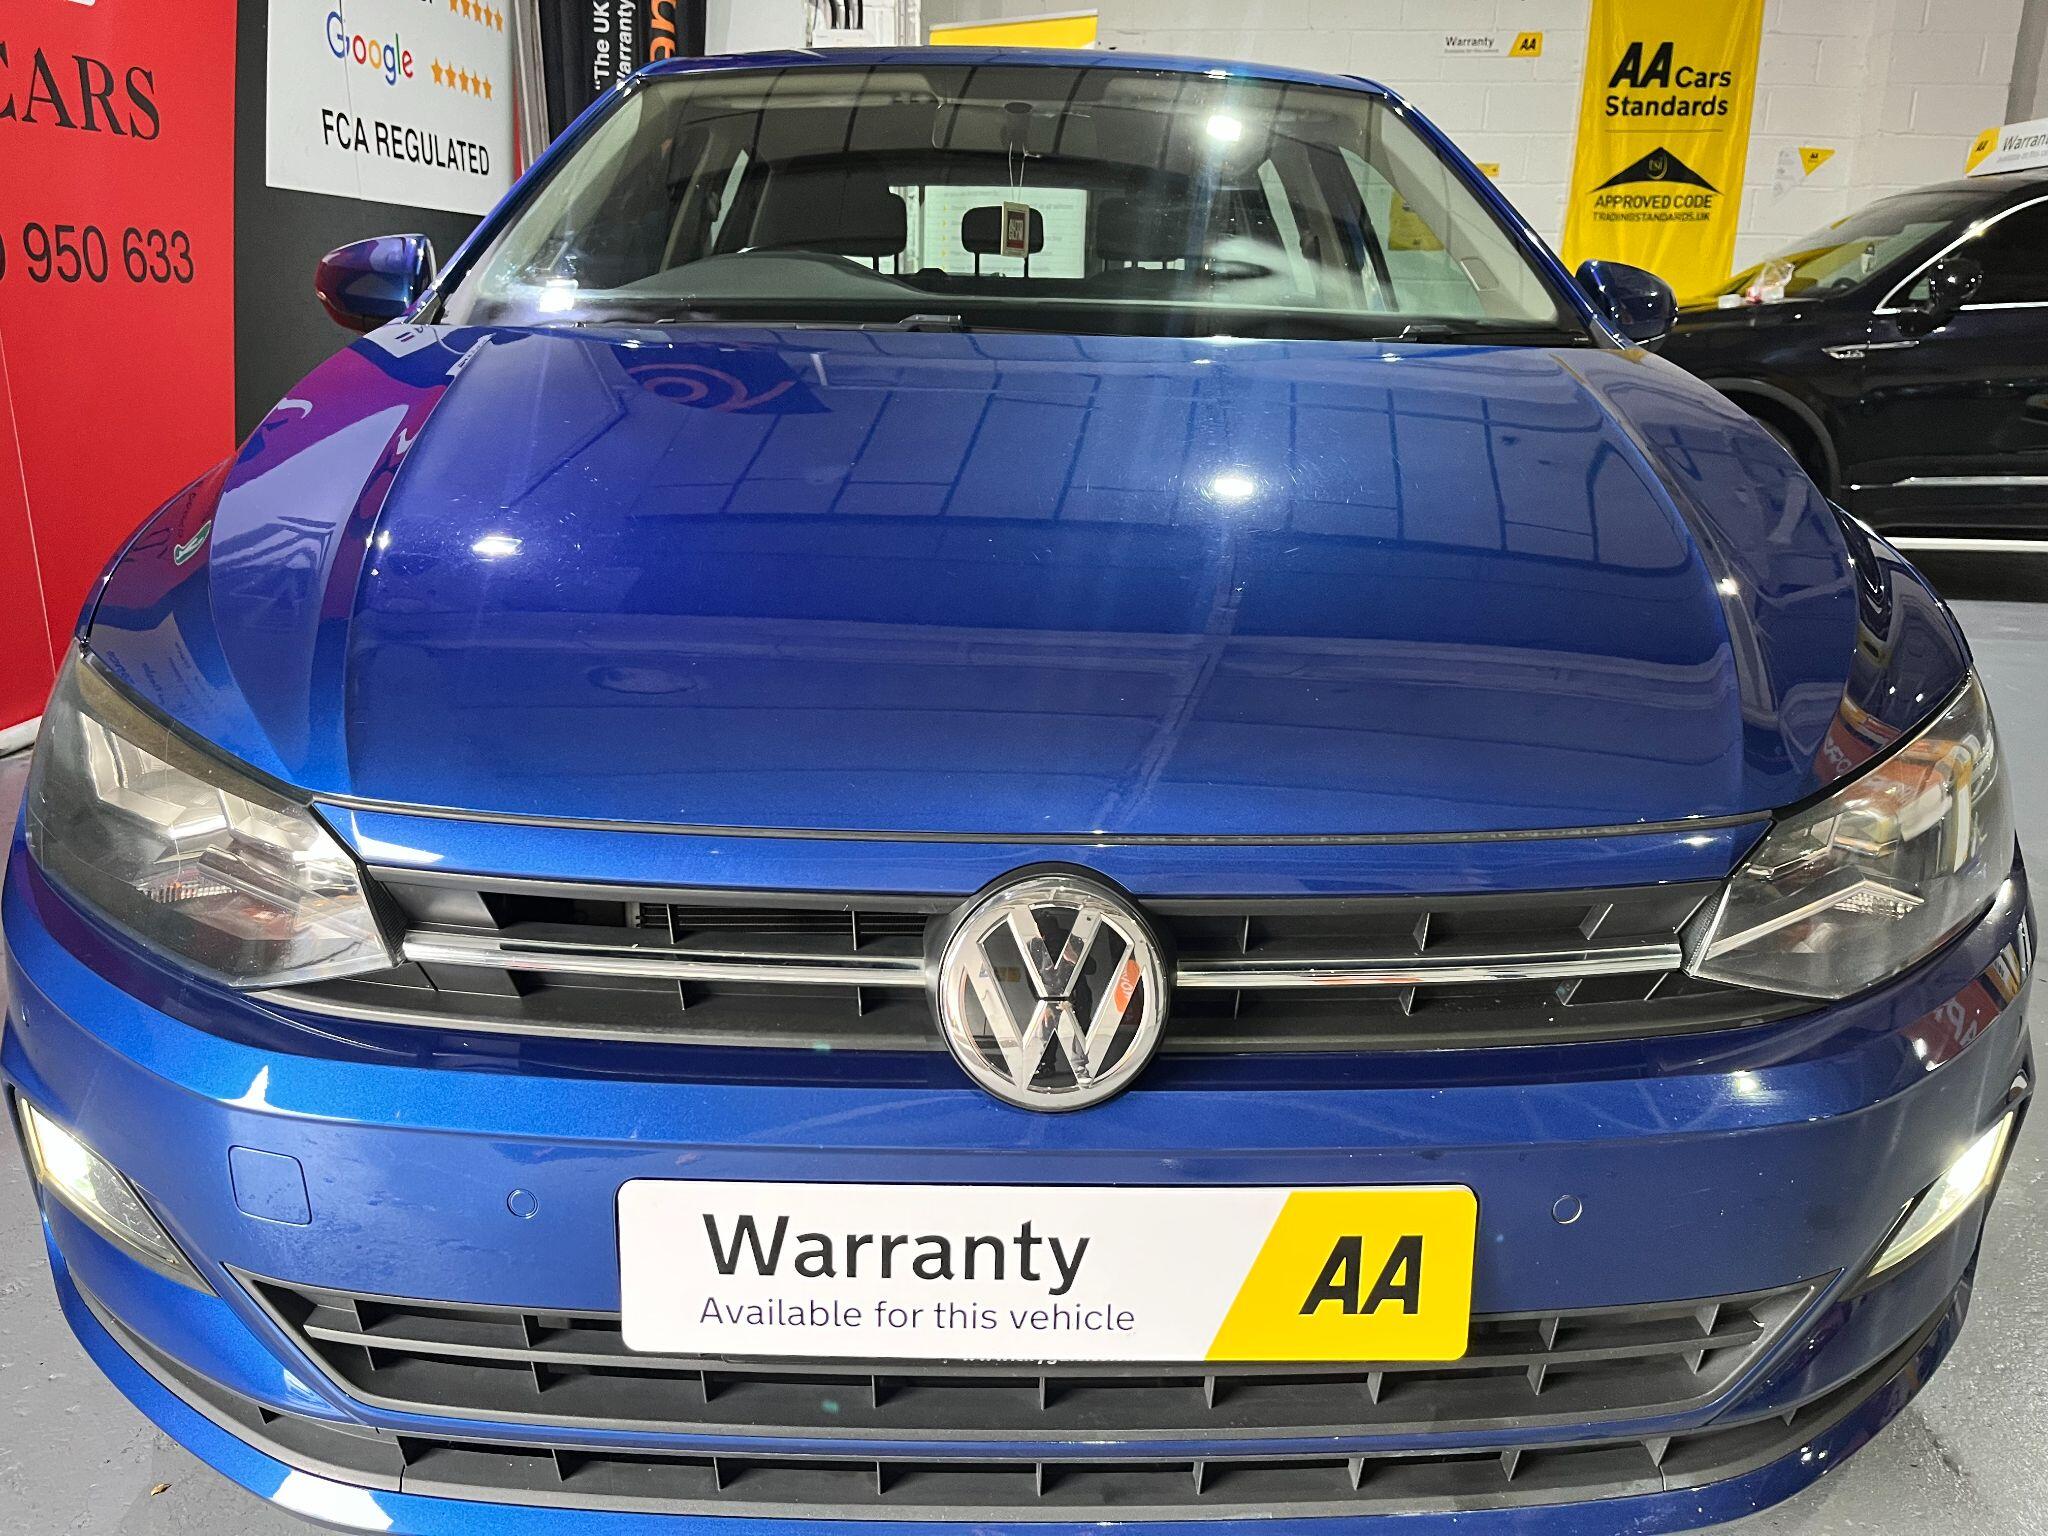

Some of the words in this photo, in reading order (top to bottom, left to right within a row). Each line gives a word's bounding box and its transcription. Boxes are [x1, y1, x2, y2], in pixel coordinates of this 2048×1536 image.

[327, 11, 414, 86] Google
[1445, 36, 1495, 48] Warranty
[1520, 38, 1536, 50] AA
[1608, 41, 1674, 88] AA
[1675, 66, 1732, 88] Cars
[1605, 95, 1728, 116] Standards
[321, 108, 370, 154] FCA
[374, 121, 490, 176] REGULATED
[2002, 133, 2048, 152] Warran
[1594, 194, 1671, 209] APPROVED
[1673, 194, 1712, 208] CODE
[23, 222, 108, 283] 950
[123, 227, 194, 283] 633
[702, 1213, 1090, 1296] Warranty
[1298, 1236, 1423, 1315] AA
[699, 1297, 862, 1328] Available
[875, 1300, 925, 1329] for
[934, 1301, 998, 1330] this
[1009, 1303, 1136, 1332] vehicle
